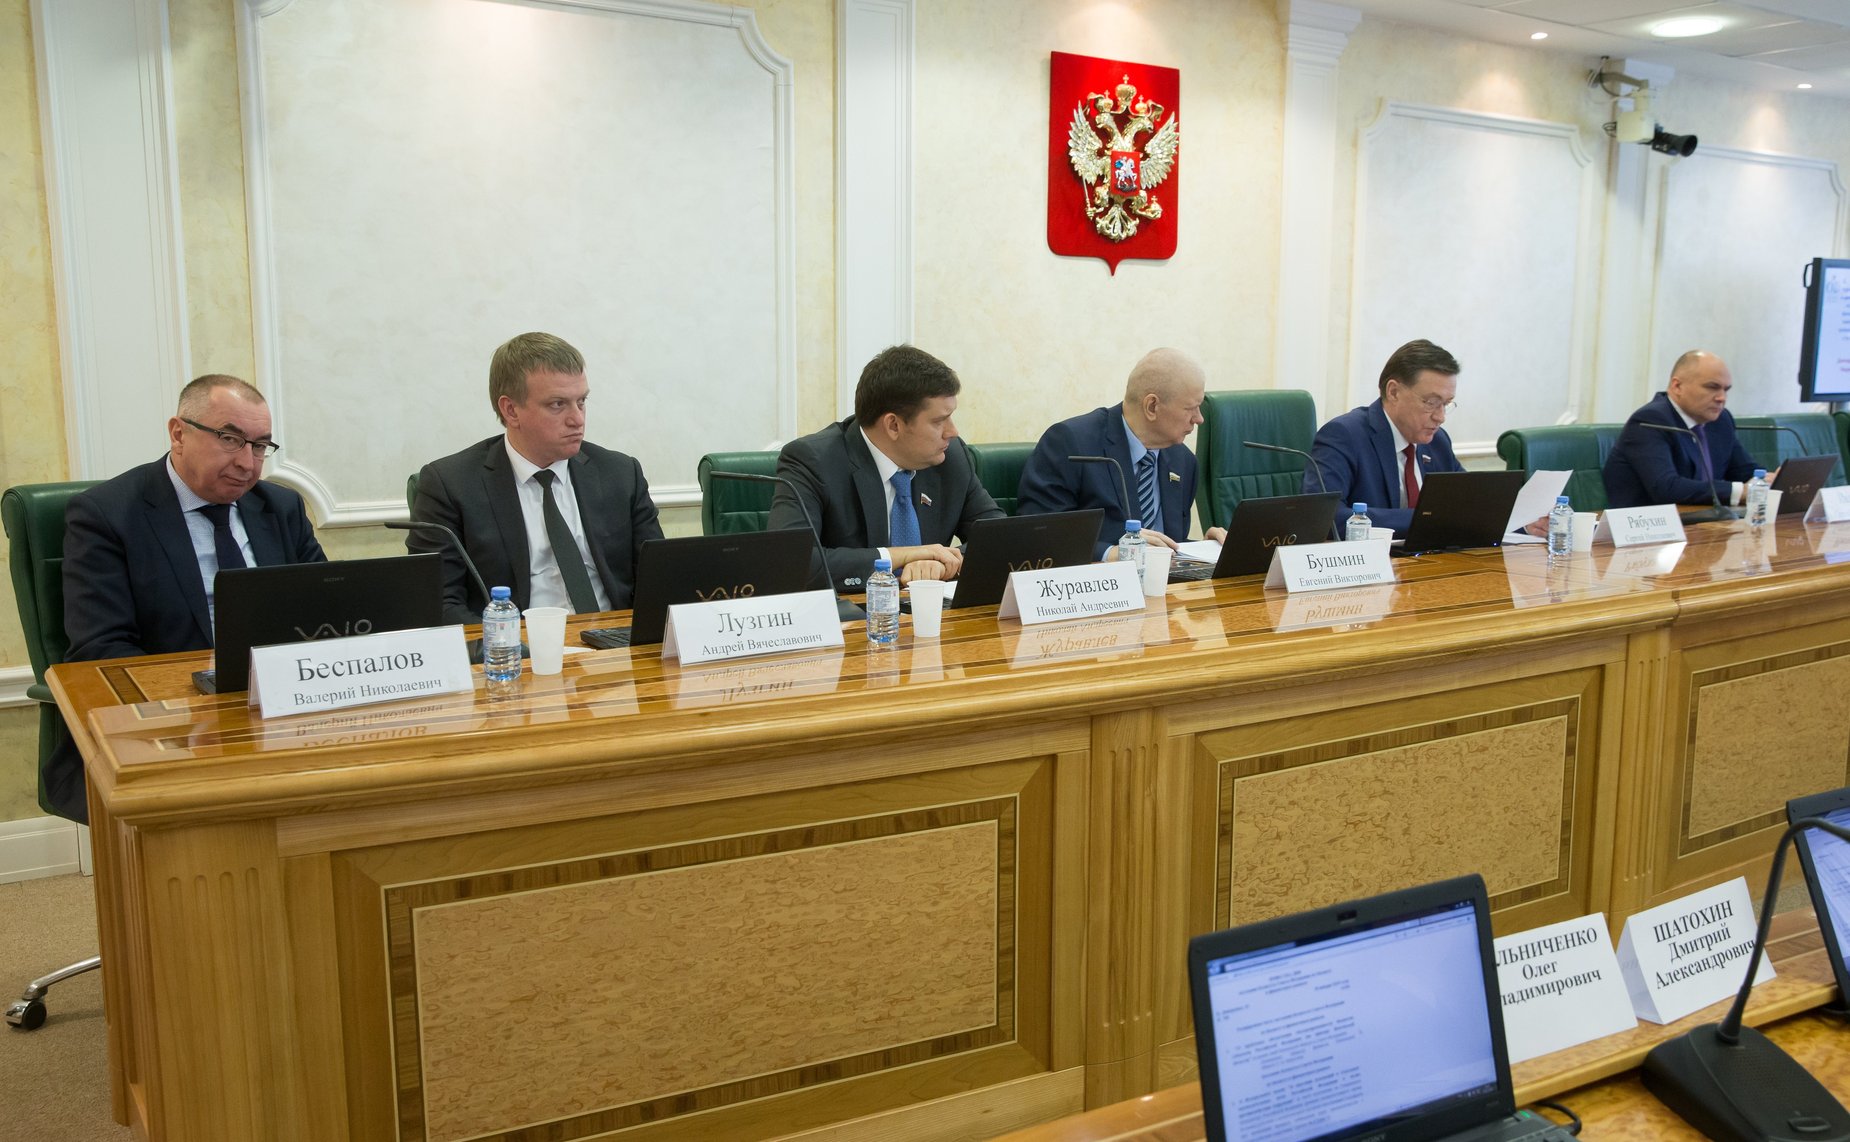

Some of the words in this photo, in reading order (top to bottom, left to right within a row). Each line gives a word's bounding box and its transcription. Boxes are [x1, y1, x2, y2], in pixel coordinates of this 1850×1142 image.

[1627, 515, 1667, 531] Рябухин
[1262, 533, 1297, 548] VAIO
[1008, 557, 1053, 572] VAIO
[1306, 553, 1366, 573] Бушмин
[1036, 577, 1119, 601] Журавлев
[1299, 576, 1336, 587] Евгений
[1335, 573, 1381, 584] Викторович
[696, 583, 755, 601] VAIO
[1036, 602, 1078, 617] Николай
[1080, 599, 1130, 614] Андреевич
[294, 618, 373, 641] VAIO
[717, 611, 793, 637] Лузгин
[701, 638, 745, 656] Андрей
[747, 633, 823, 651] Вячеславович
[296, 651, 425, 682] Беспалов
[293, 686, 356, 706] Валерий
[360, 678, 443, 698] Николаевич
[1652, 899, 1735, 943] ШАТОХИН
[1497, 926, 1598, 967] ЛЬНИЧЕНКО
[1667, 922, 1732, 963] Дмитрий
[1522, 960, 1558, 980] Олег
[1655, 939, 1756, 989] Александрович
[1501, 968, 1603, 1007] ладимирович
